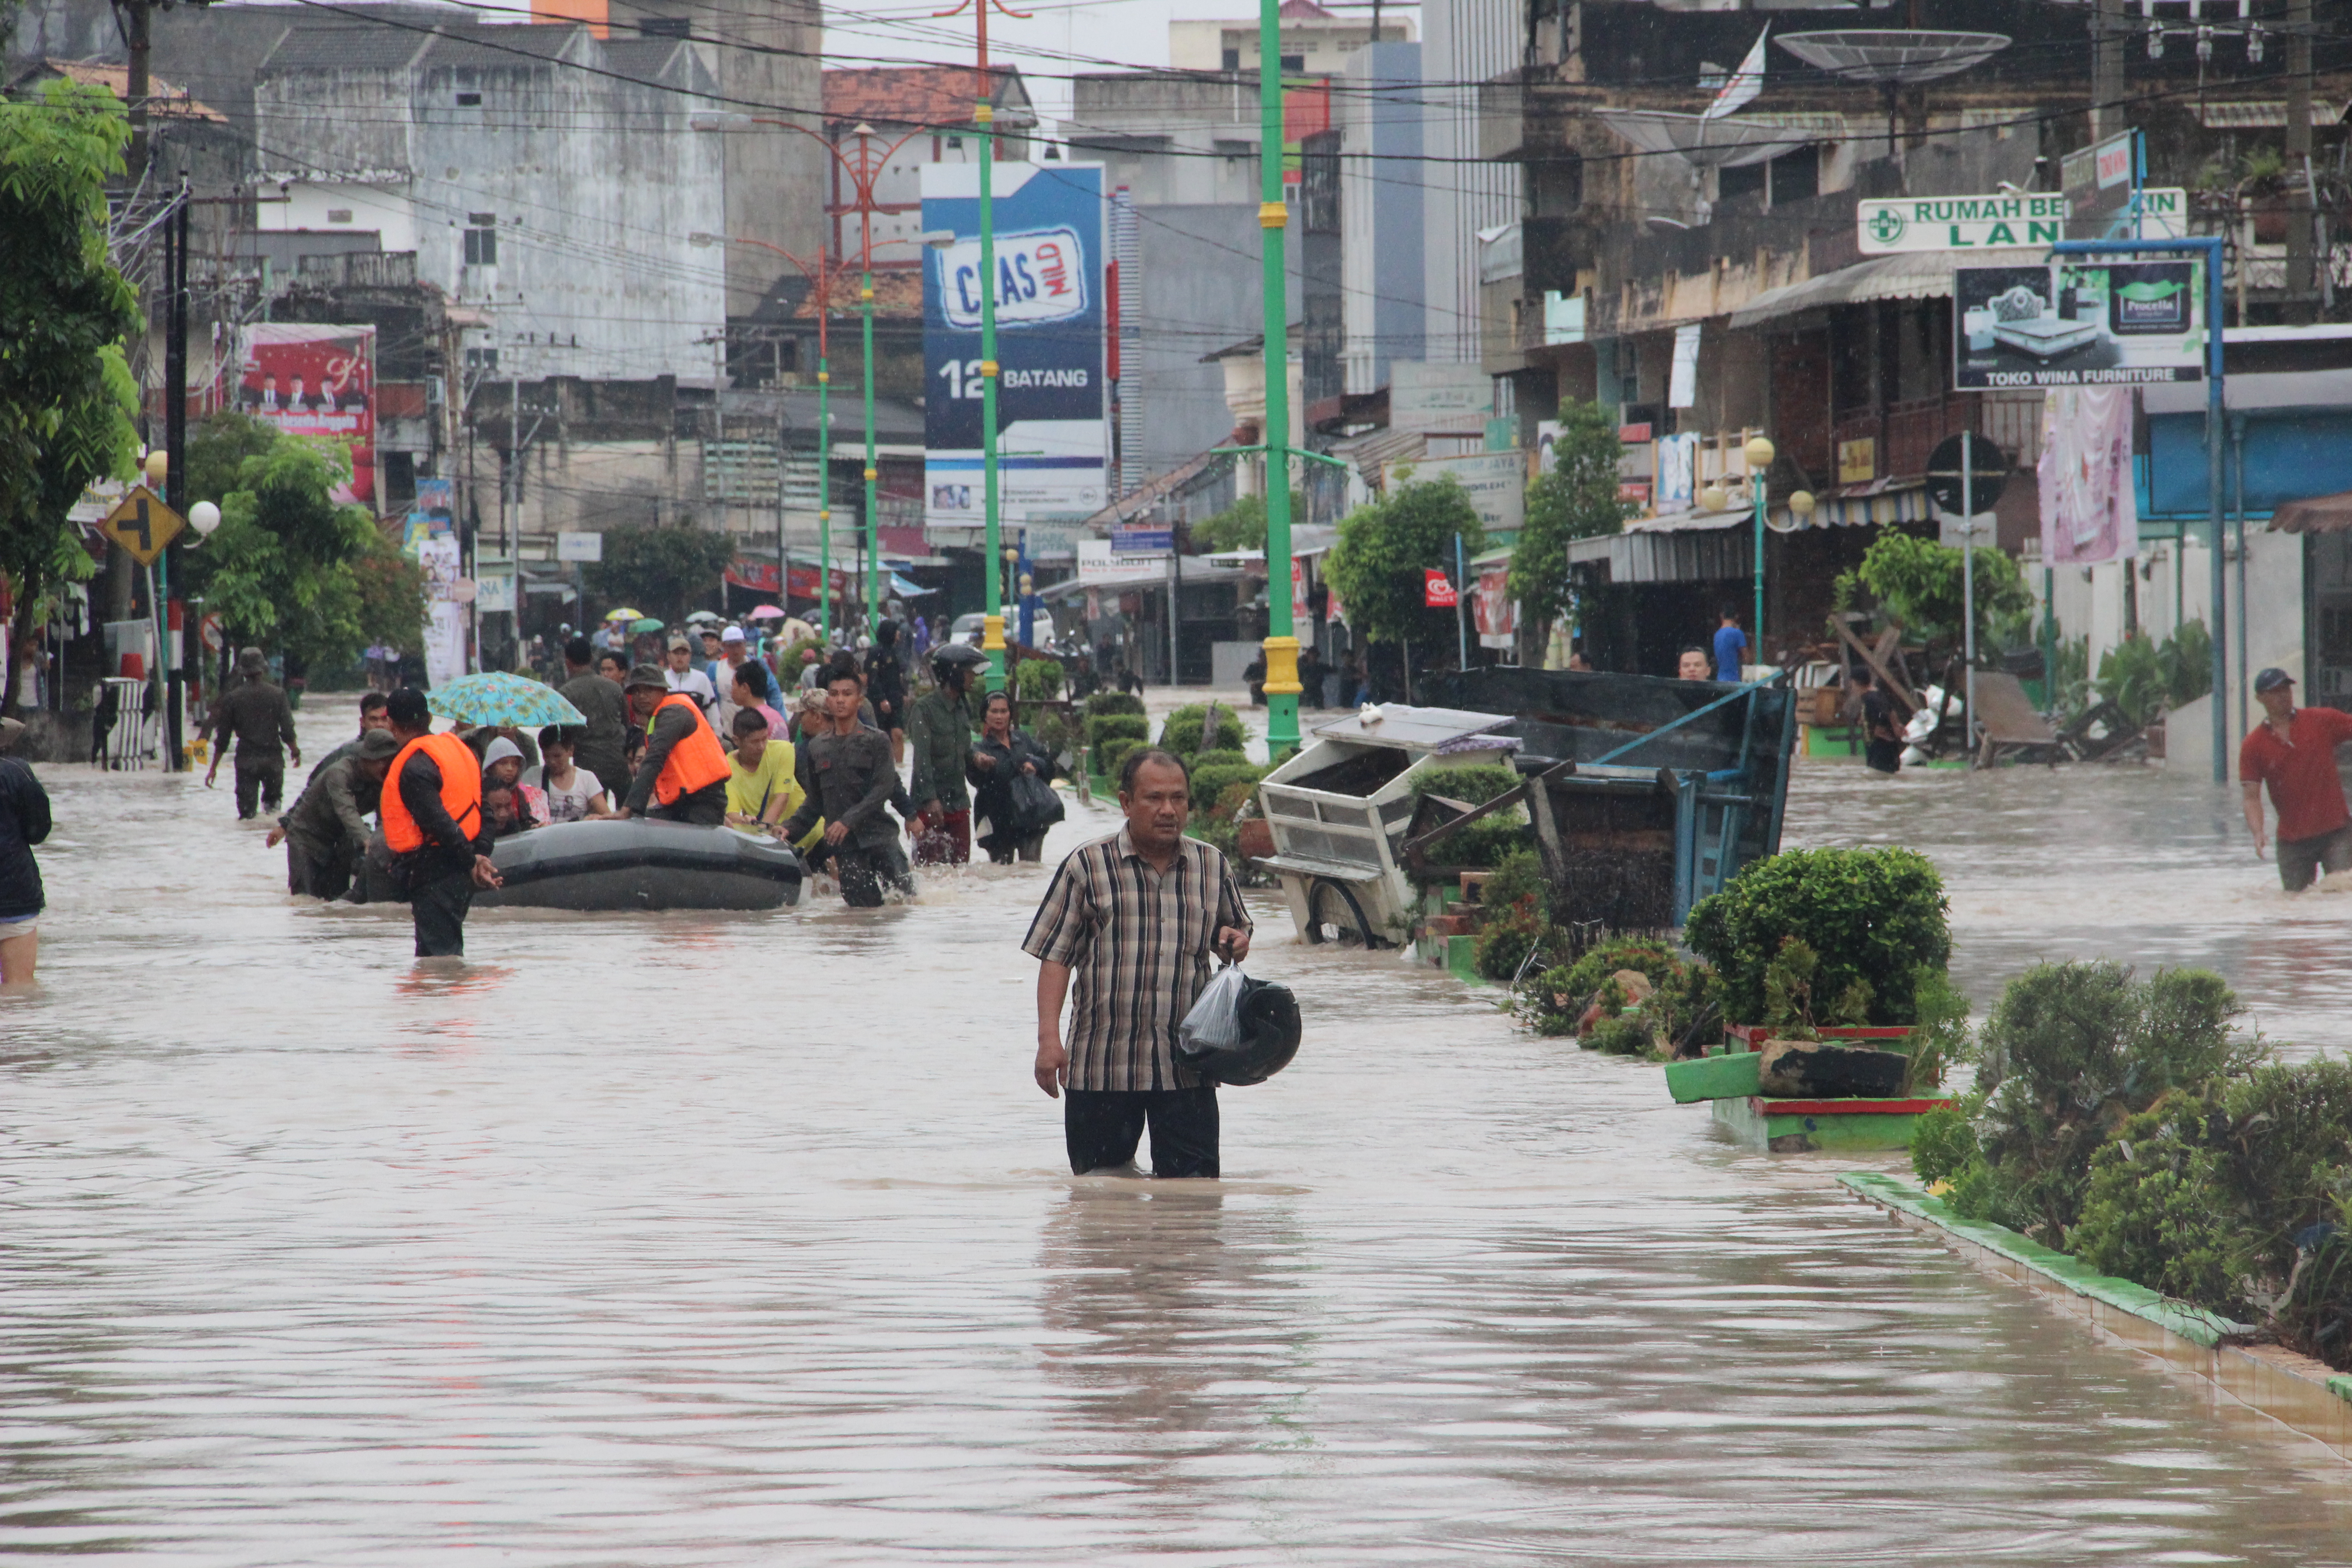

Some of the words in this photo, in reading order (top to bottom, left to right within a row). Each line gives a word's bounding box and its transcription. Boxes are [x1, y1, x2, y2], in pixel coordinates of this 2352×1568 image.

[1915, 199, 2021, 222] RUMAH
[1036, 242, 1073, 298] MILD
[956, 252, 1037, 314] CAS
[1004, 369, 1088, 388] BATANG
[1986, 371, 2031, 386] TOKO
[2035, 369, 2078, 385] WINA
[2082, 368, 2176, 384] FURNITURE
